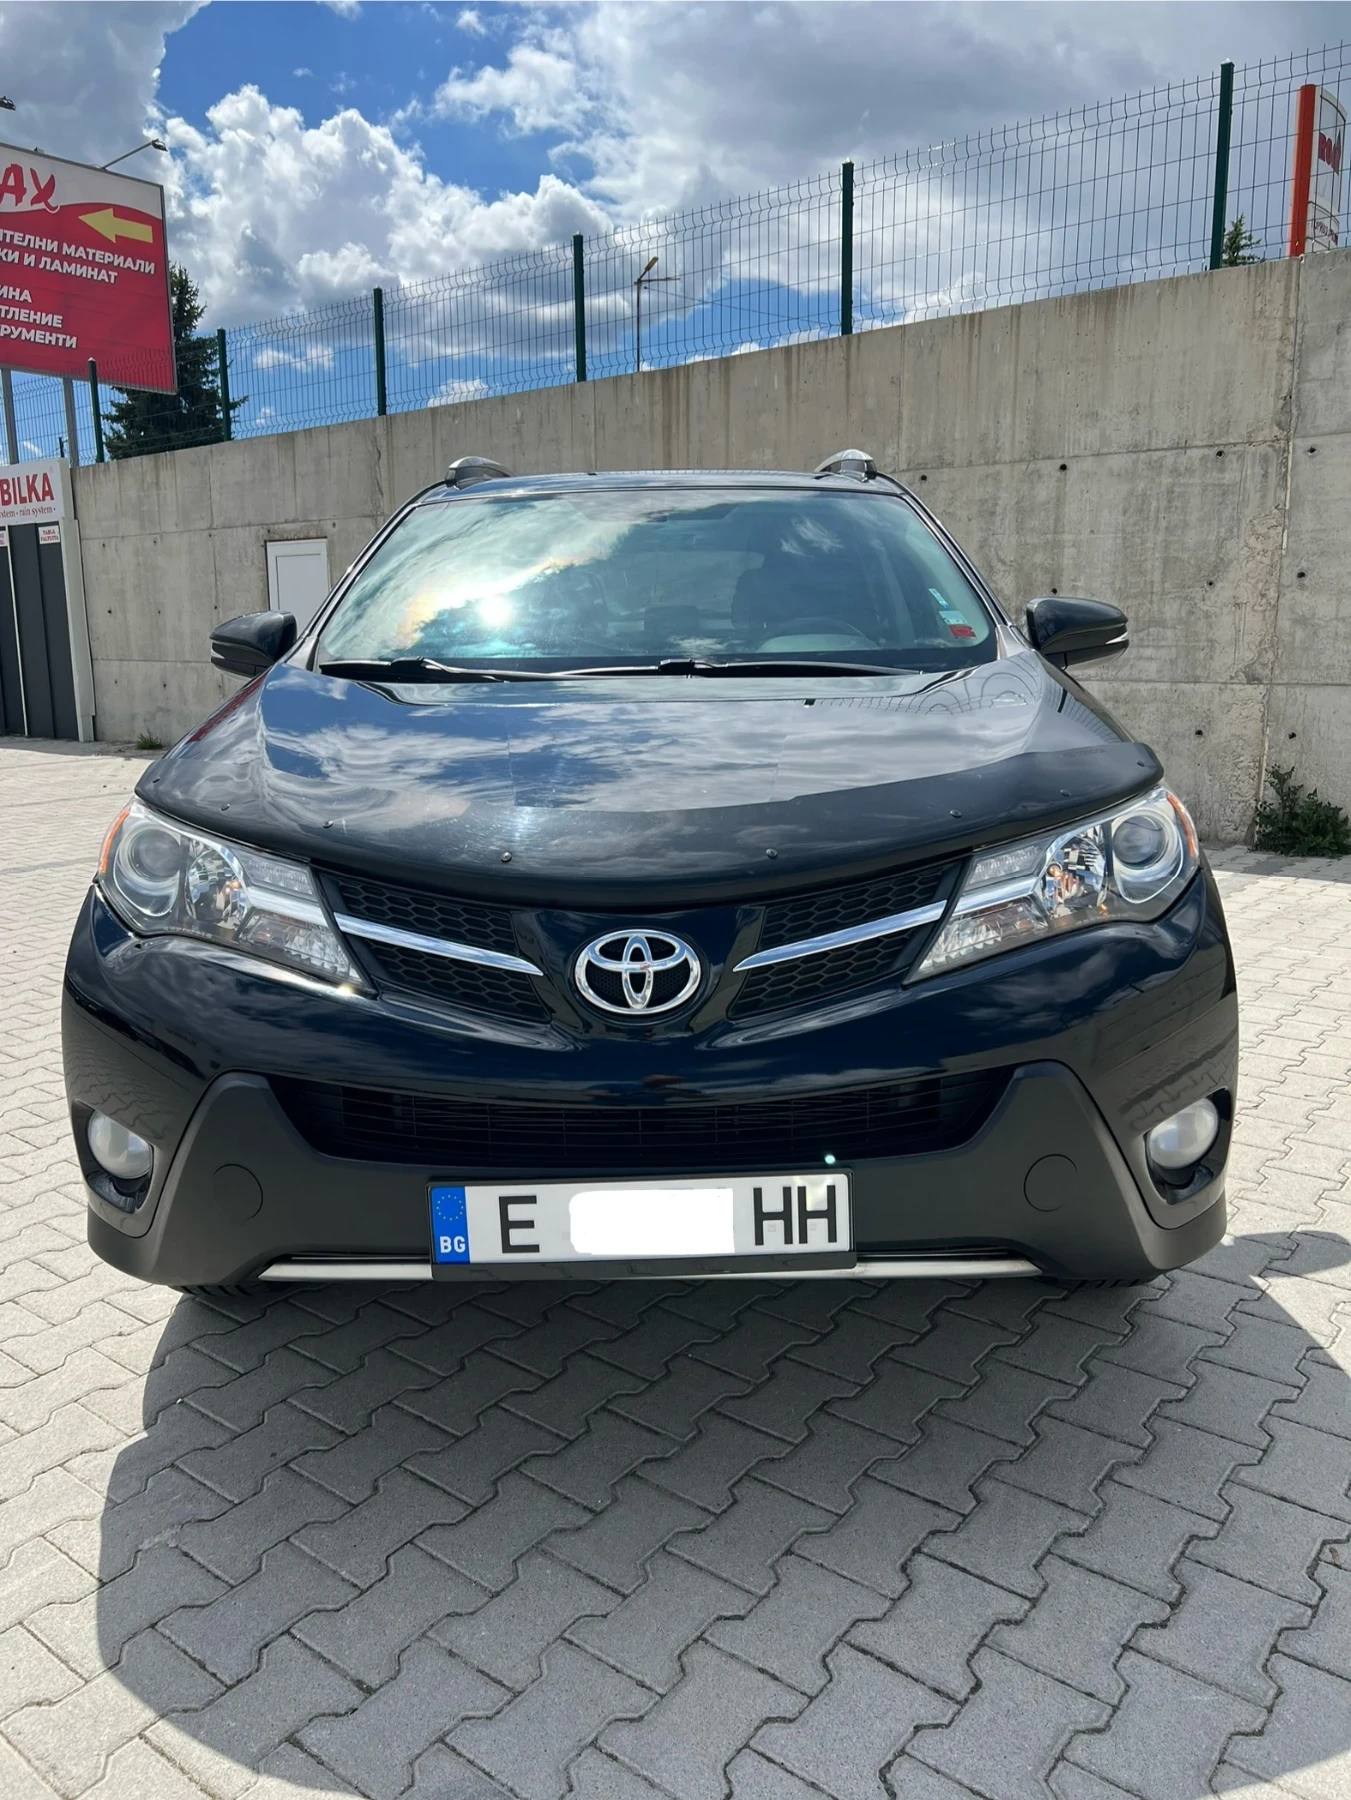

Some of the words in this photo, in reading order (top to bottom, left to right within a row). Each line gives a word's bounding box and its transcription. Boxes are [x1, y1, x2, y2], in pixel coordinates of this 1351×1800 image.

[23, 252, 36, 267] И
[39, 257, 118, 284] ЛАМИНАТ
[62, 243, 155, 274] МАТЕРИАЛИ
[0, 472, 54, 506] BILKA
[32, 506, 53, 517] system
[498, 1195, 540, 1254] E
[753, 1184, 838, 1247] HH
[440, 1235, 466, 1254] BG
